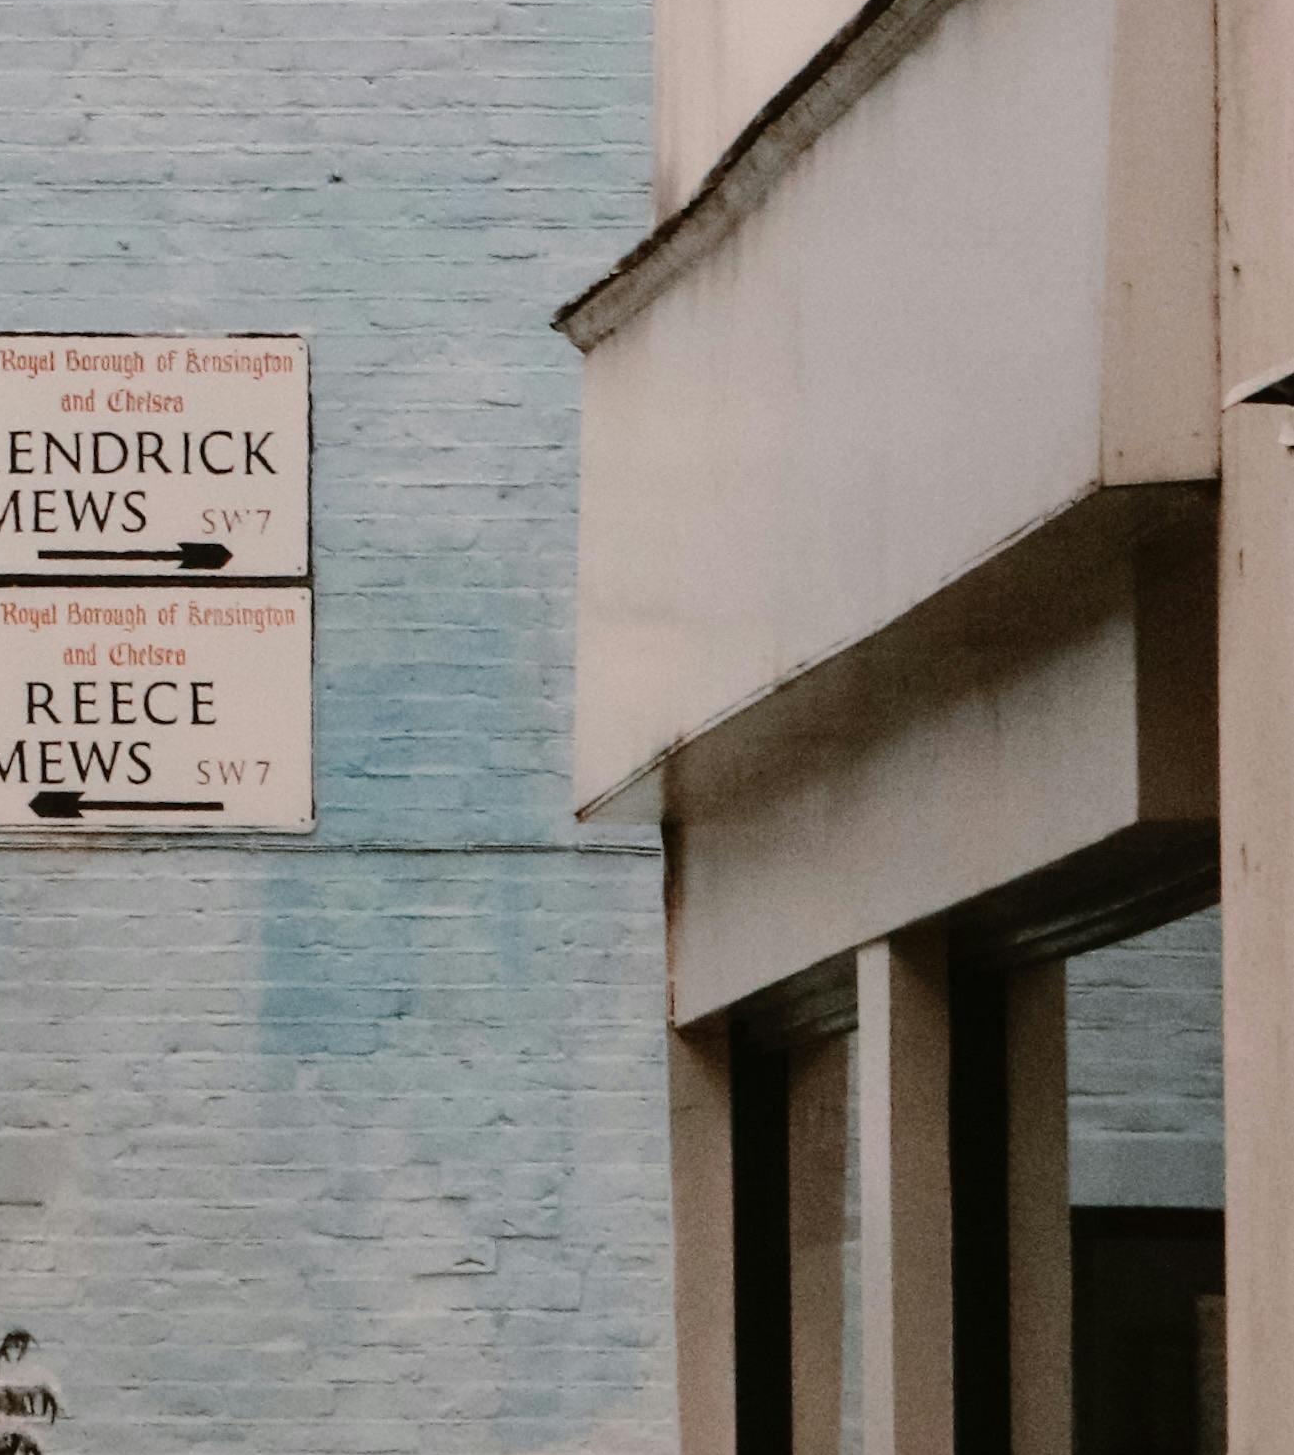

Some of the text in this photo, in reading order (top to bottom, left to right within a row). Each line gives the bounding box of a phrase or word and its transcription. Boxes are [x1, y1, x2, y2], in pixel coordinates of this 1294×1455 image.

[0, 349, 56, 378] Royal
[66, 349, 145, 379] Borough
[157, 350, 177, 373] of
[185, 349, 293, 380] Kensington
[61, 390, 184, 413] and Chelsea
[1, 603, 58, 632] Royal
[67, 603, 147, 632] Borough
[158, 603, 179, 627] of
[188, 603, 296, 633] Kensington
[63, 643, 186, 667] and Chelsea
[25, 681, 216, 726] REECE
